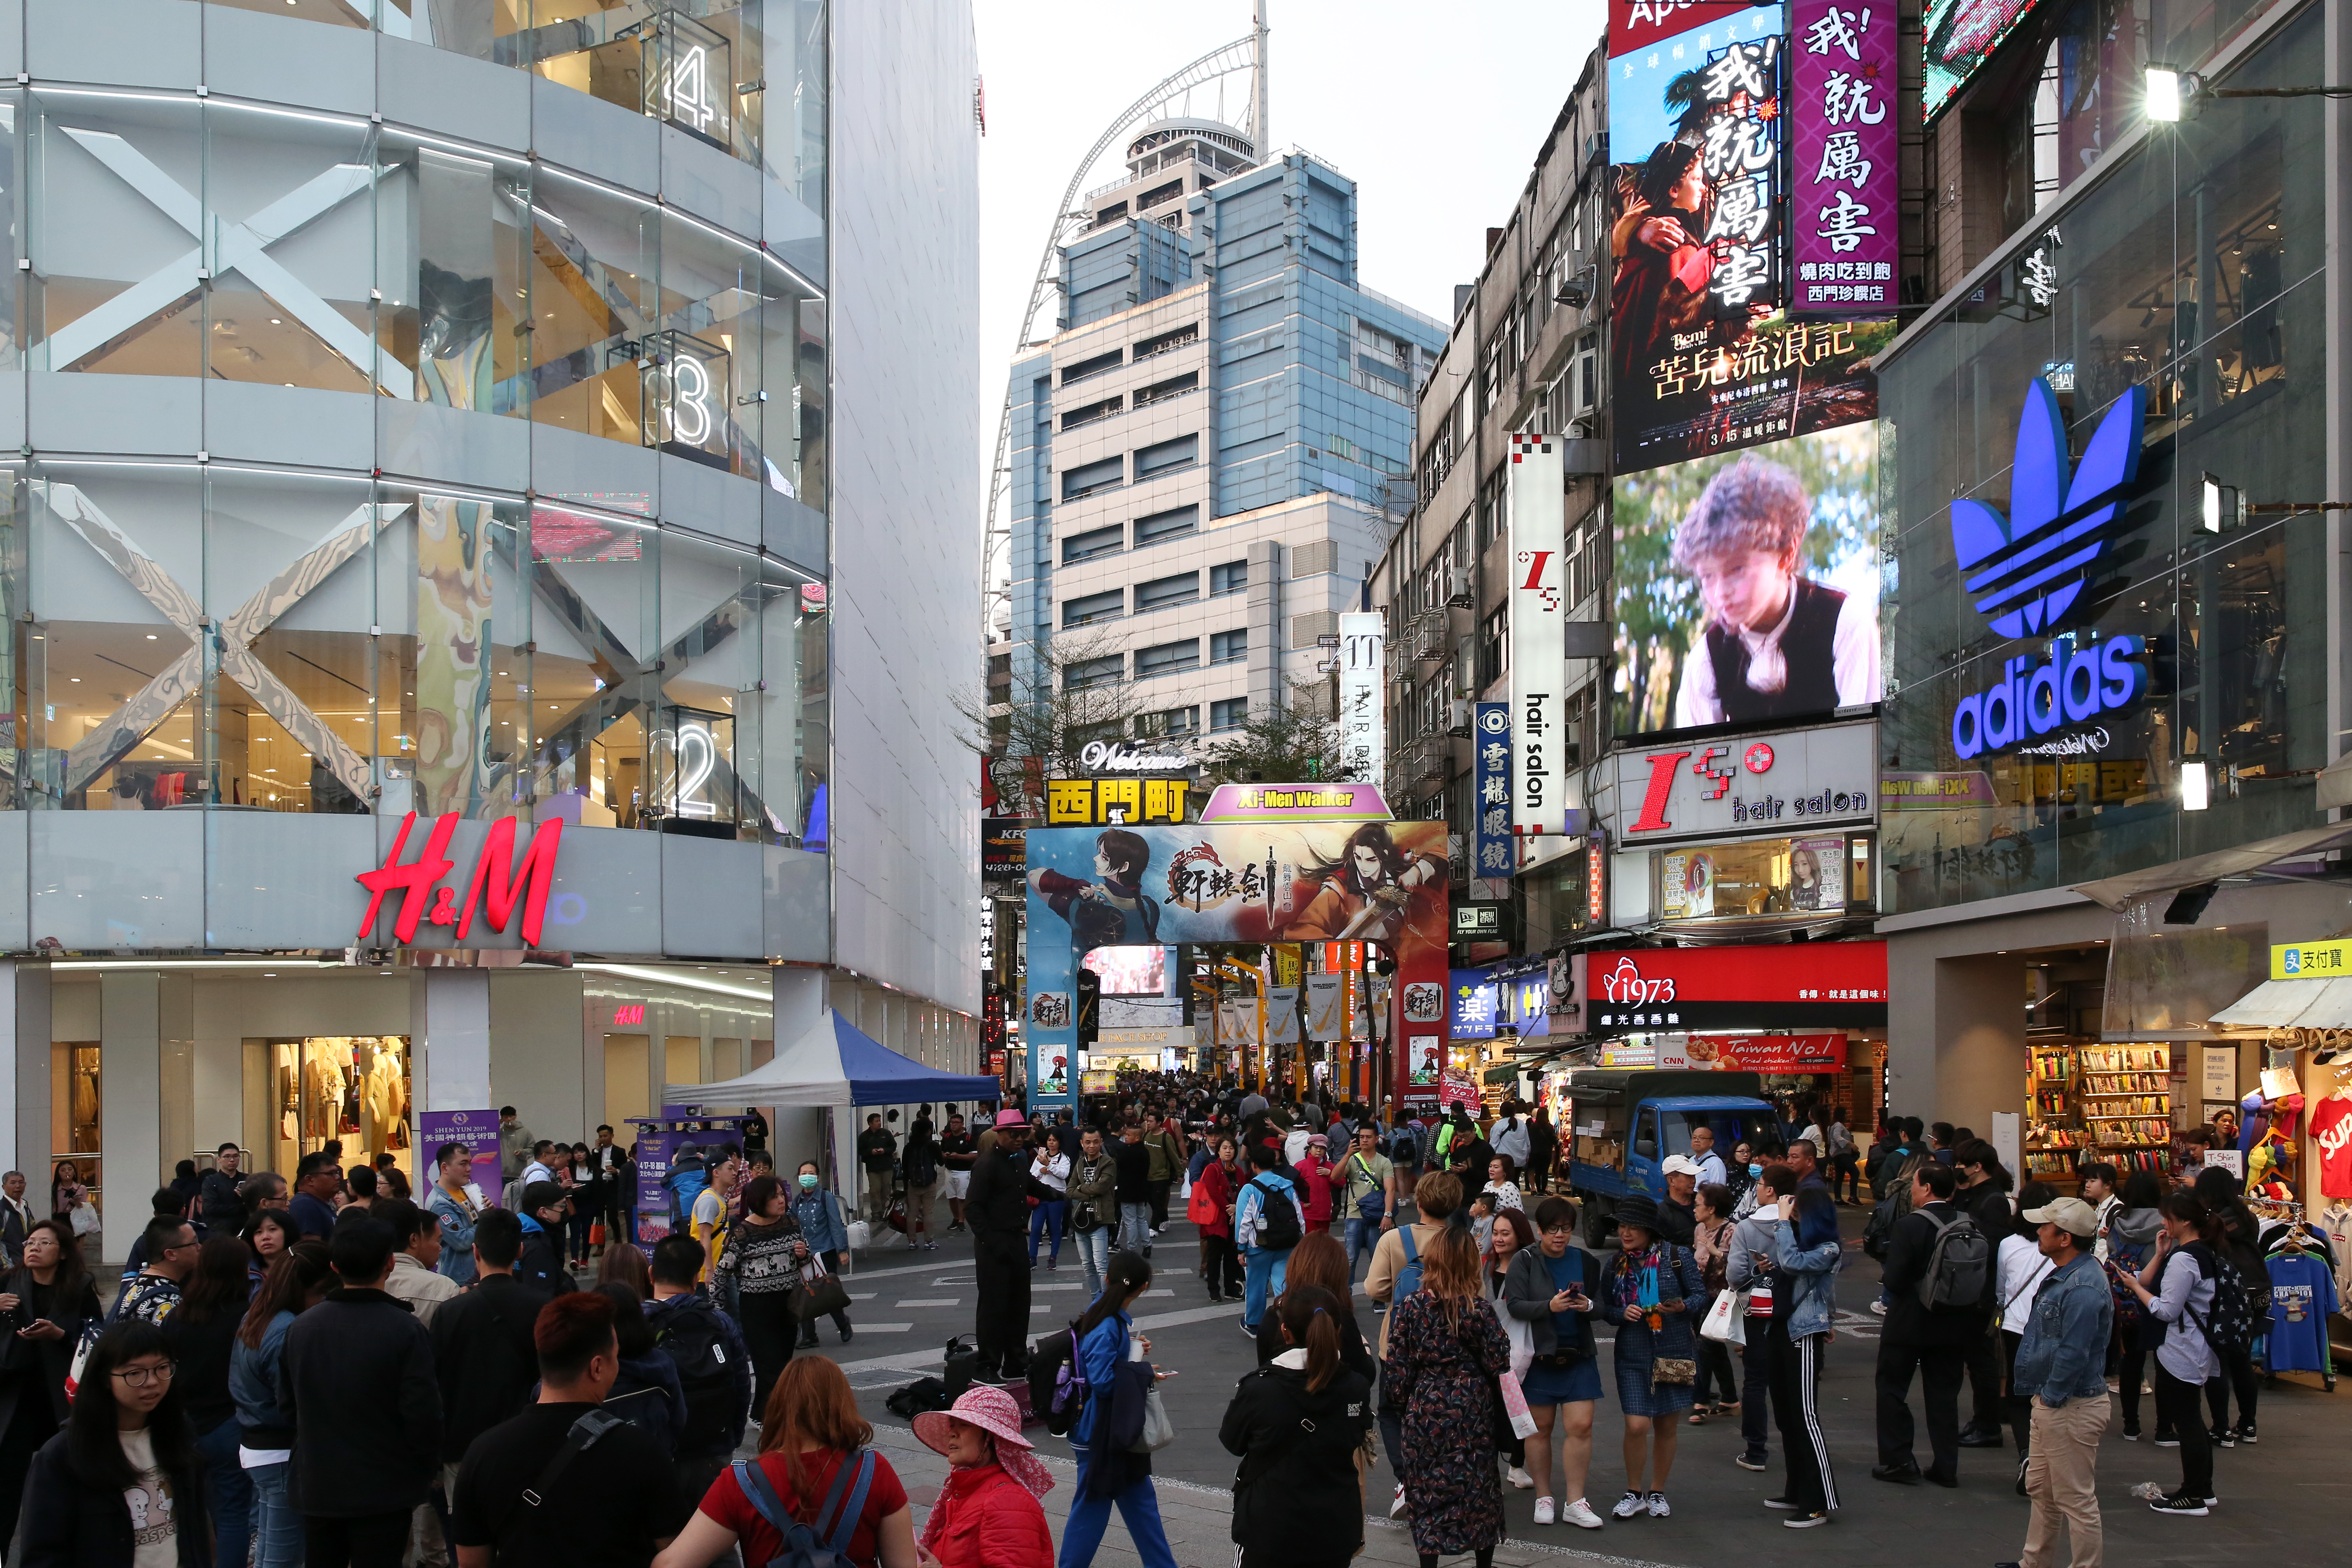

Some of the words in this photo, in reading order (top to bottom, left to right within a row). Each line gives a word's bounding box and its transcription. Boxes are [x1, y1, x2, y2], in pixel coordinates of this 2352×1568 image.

[664, 44, 713, 134] 4
[1800, 261, 1891, 282] 燒肉吃到飽
[1670, 327, 1708, 346] Remi
[1649, 321, 1855, 401] 苦兒流浪記
[2046, 362, 2064, 372] sty
[665, 354, 711, 445] 3
[1355, 685, 1370, 733] HAIR
[1952, 635, 2140, 760] adidas
[1526, 694, 1549, 737] hair
[1080, 739, 1189, 771] Welcome
[670, 724, 717, 816] 2
[1526, 743, 1549, 808] salon
[1048, 780, 1190, 824] 西門町
[1237, 790, 1295, 809] Xi-Men
[1295, 790, 1354, 808] Walker
[1481, 742, 1510, 870] 雪龍眼鏡
[1732, 795, 1784, 822] hair
[1793, 788, 1866, 815] salon
[355, 811, 564, 947] H&M
[1282, 863, 1293, 900] 龍舞雲山
[1820, 885, 1842, 894] 離子燙
[980, 896, 993, 971] 台灣伴手禮
[1287, 957, 1298, 984] 馬茶
[2302, 949, 2342, 969] 支付寶
[1621, 977, 1675, 1009] 1973
[614, 1005, 645, 1025] H&M
[1453, 1024, 1494, 1033] サツドラ
[1600, 1013, 1679, 1026] 繼光香香雞
[1109, 1032, 1137, 1043] FACE
[1138, 1031, 1168, 1042] SHOP
[1727, 1039, 1782, 1054] Taiwan
[1786, 1036, 1833, 1055] No.1
[1442, 1080, 1475, 1091] Taiwan
[1449, 1087, 1476, 1098] No.1
[424, 1132, 497, 1142] 美國神韻藝術團
[639, 1161, 655, 1169] 4/17-18
[655, 1162, 666, 1170] 基隆
[2207, 1153, 2234, 1162] T-Shirt
